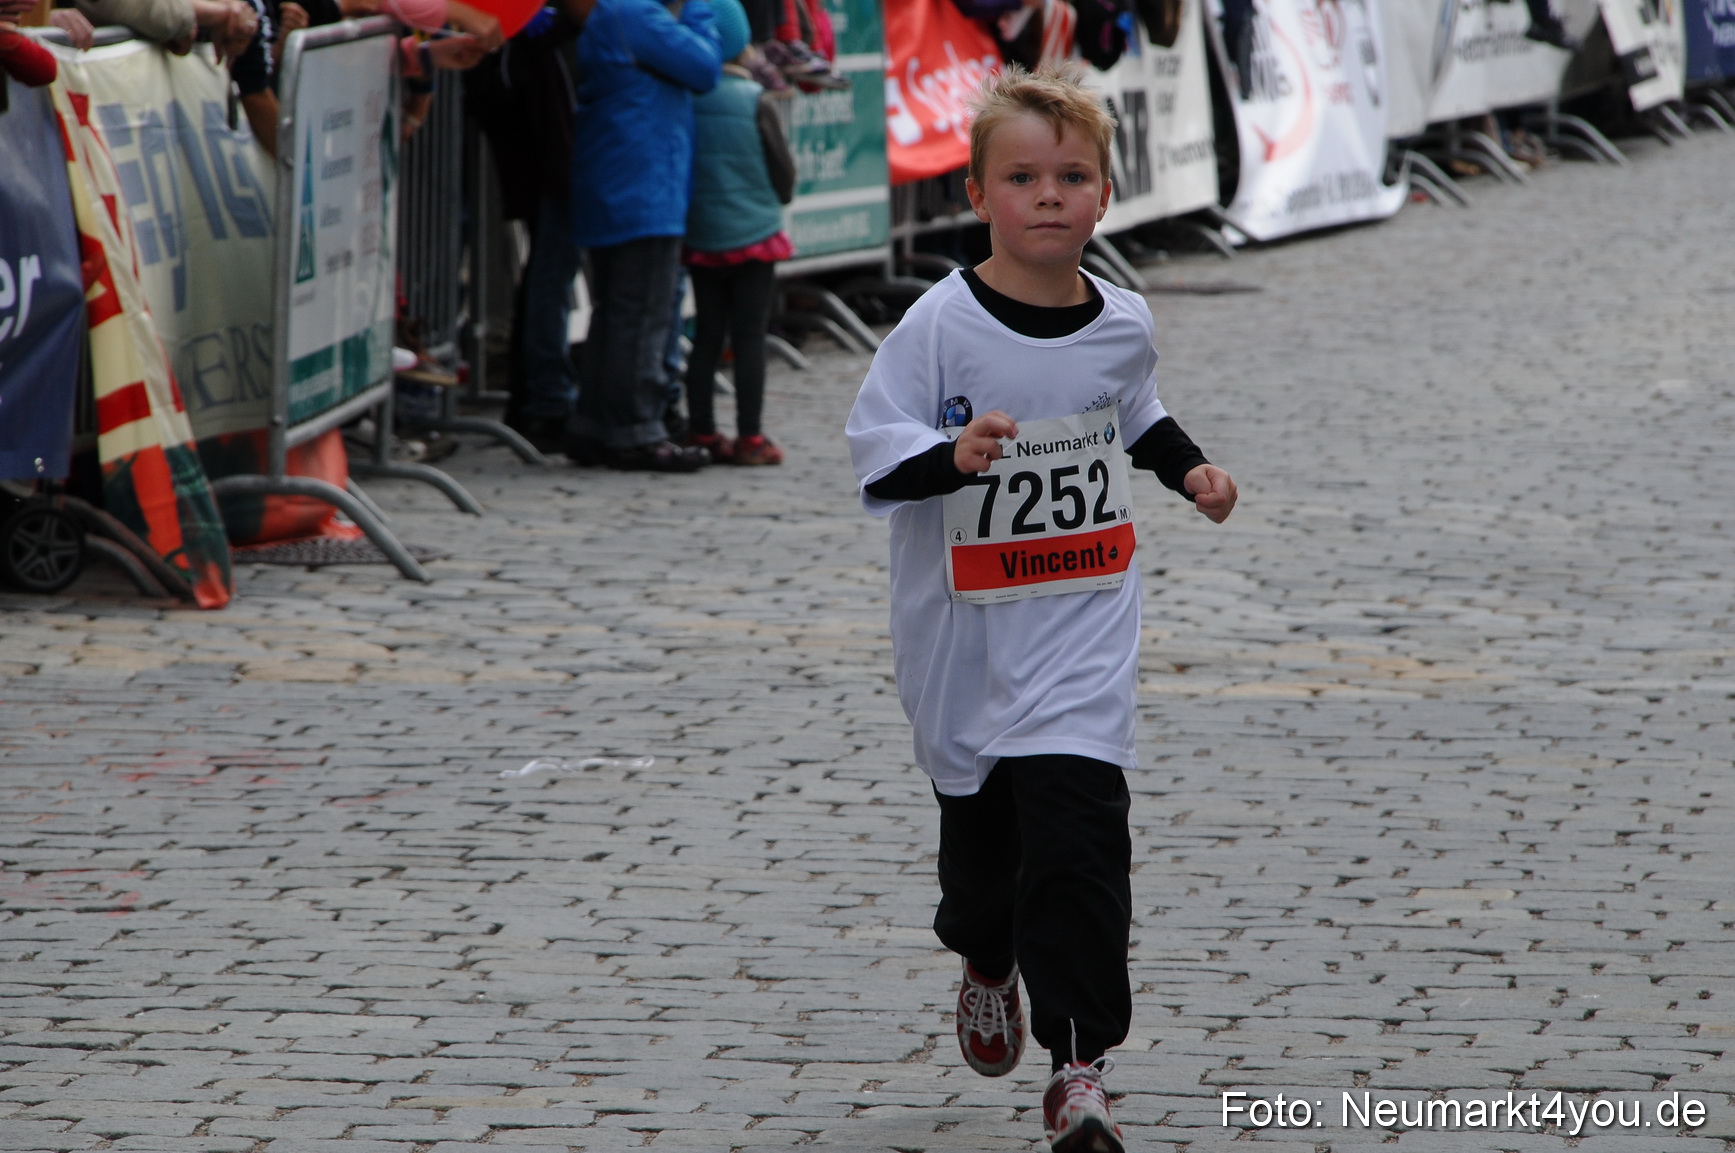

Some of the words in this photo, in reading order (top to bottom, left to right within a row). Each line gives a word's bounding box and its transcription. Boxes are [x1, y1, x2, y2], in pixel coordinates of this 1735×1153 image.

[1016, 431, 1099, 458] Neumarkt
[965, 458, 1117, 539] 7252
[1000, 541, 1106, 579] Vincent
